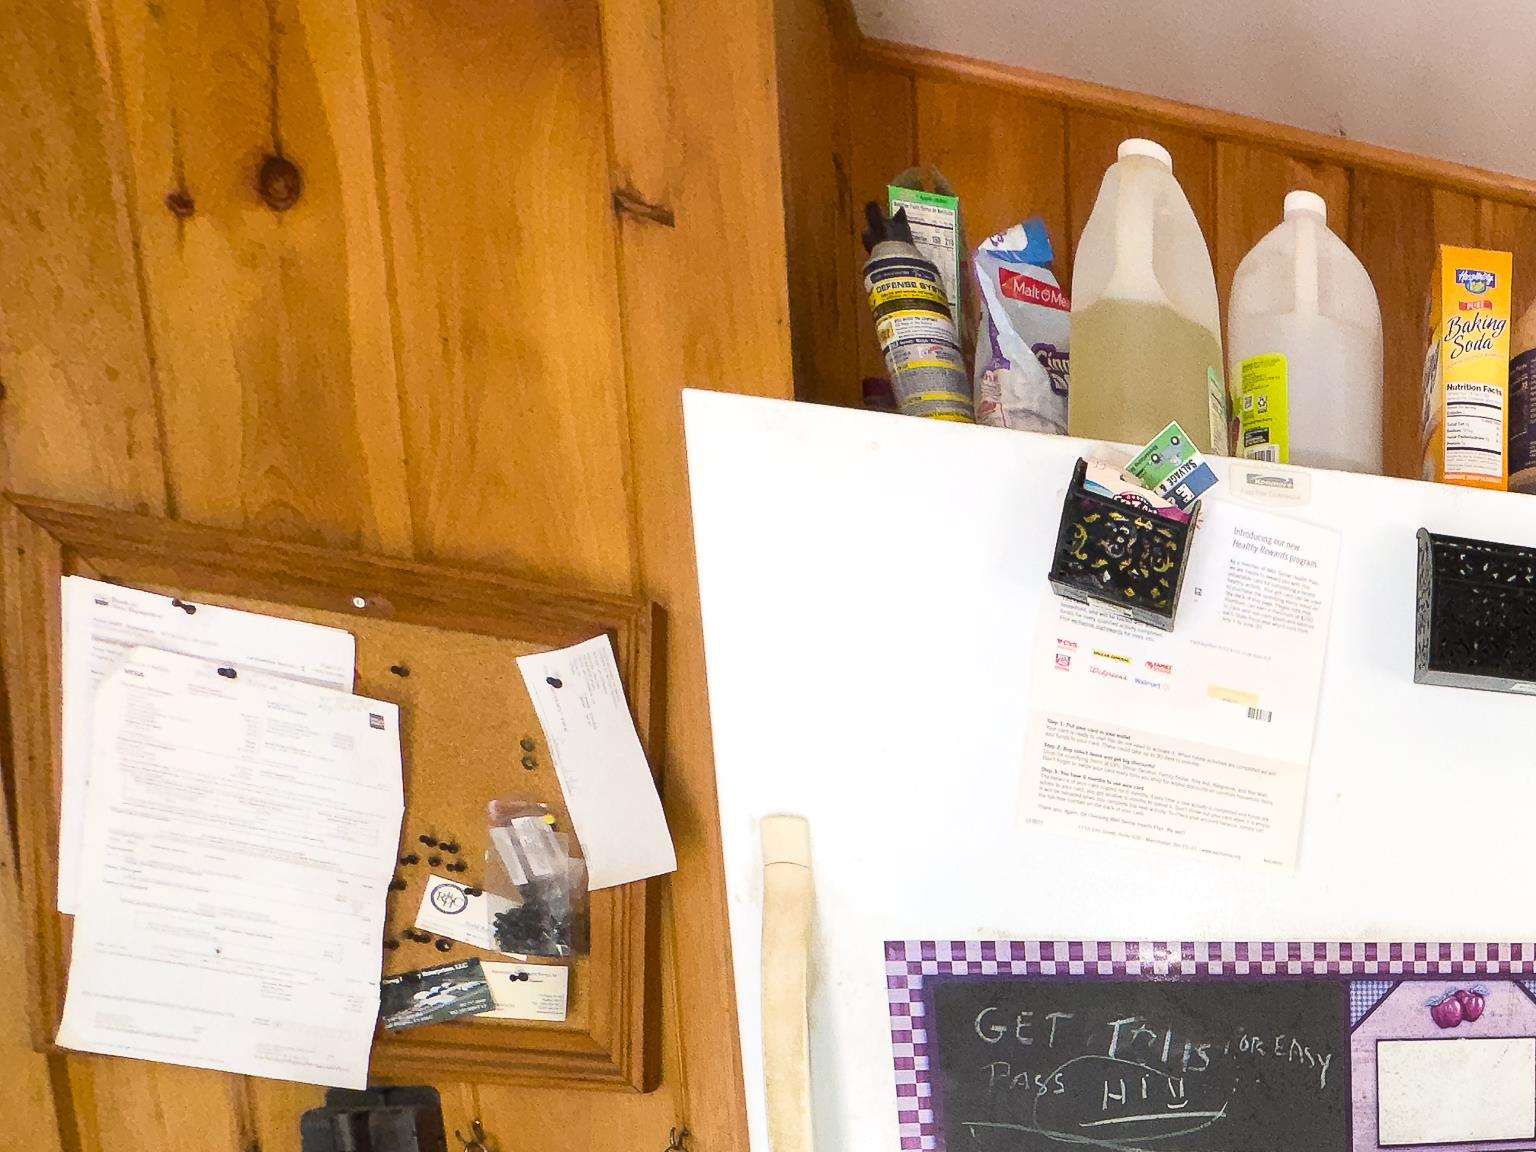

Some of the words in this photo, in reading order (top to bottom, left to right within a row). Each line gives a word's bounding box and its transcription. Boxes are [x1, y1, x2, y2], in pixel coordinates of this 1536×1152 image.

[1013, 279, 1040, 301] Malt
[1444, 312, 1507, 342] Baking
[1450, 333, 1493, 360] Soda
[1447, 383, 1481, 392] Nutrition
[1483, 385, 1502, 396] Facts
[1168, 459, 1198, 486] SALVAGE
[1289, 554, 1318, 569] program
[975, 1007, 1073, 1047] GET
[1238, 1033, 1265, 1057] OR
[1274, 1035, 1333, 1090] EASY
[980, 1061, 1066, 1096] PASS
